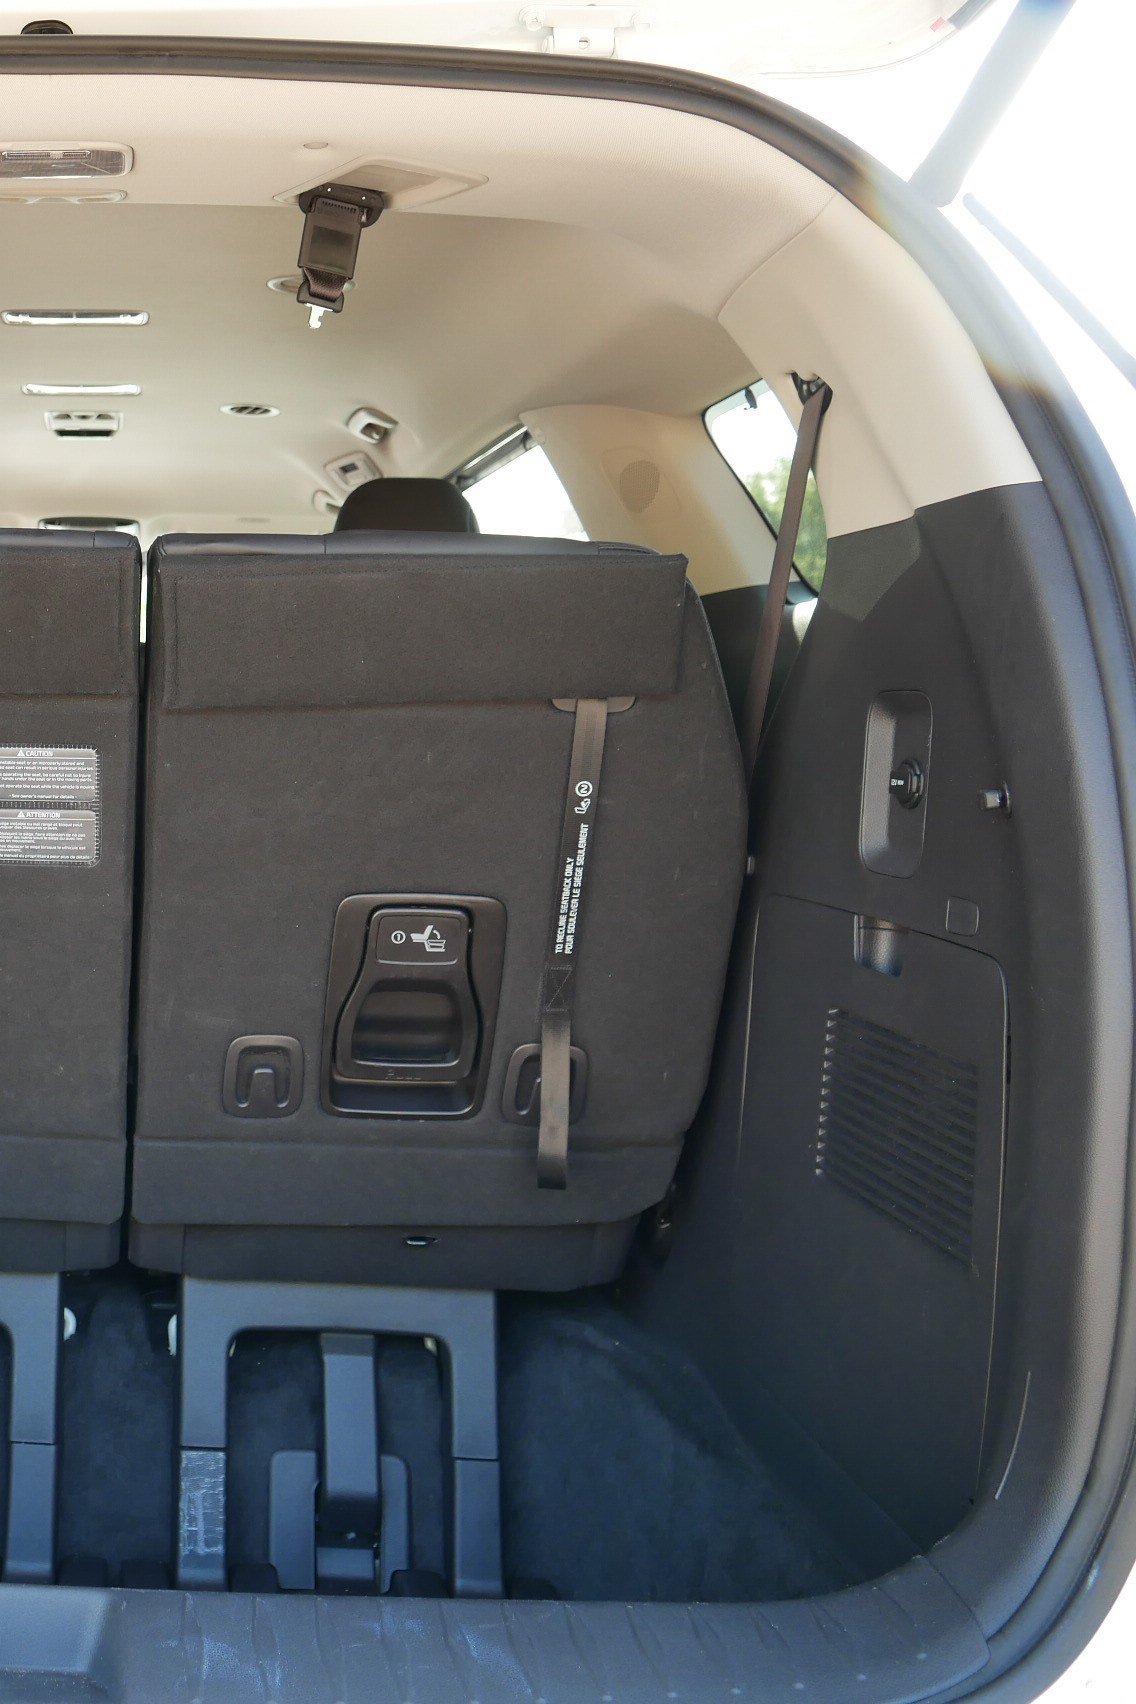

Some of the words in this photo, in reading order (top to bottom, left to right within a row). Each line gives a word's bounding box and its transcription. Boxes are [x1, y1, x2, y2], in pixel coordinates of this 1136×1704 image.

[576, 823, 589, 866] SEULEMENT
[565, 857, 574, 877] ONLY
[560, 878, 572, 914] SEATBACK
[572, 887, 581, 898] LE
[556, 914, 567, 943] RECLINE
[567, 899, 579, 934] SOULEVER
[555, 944, 563, 954] TO
[565, 935, 574, 954] POUR
